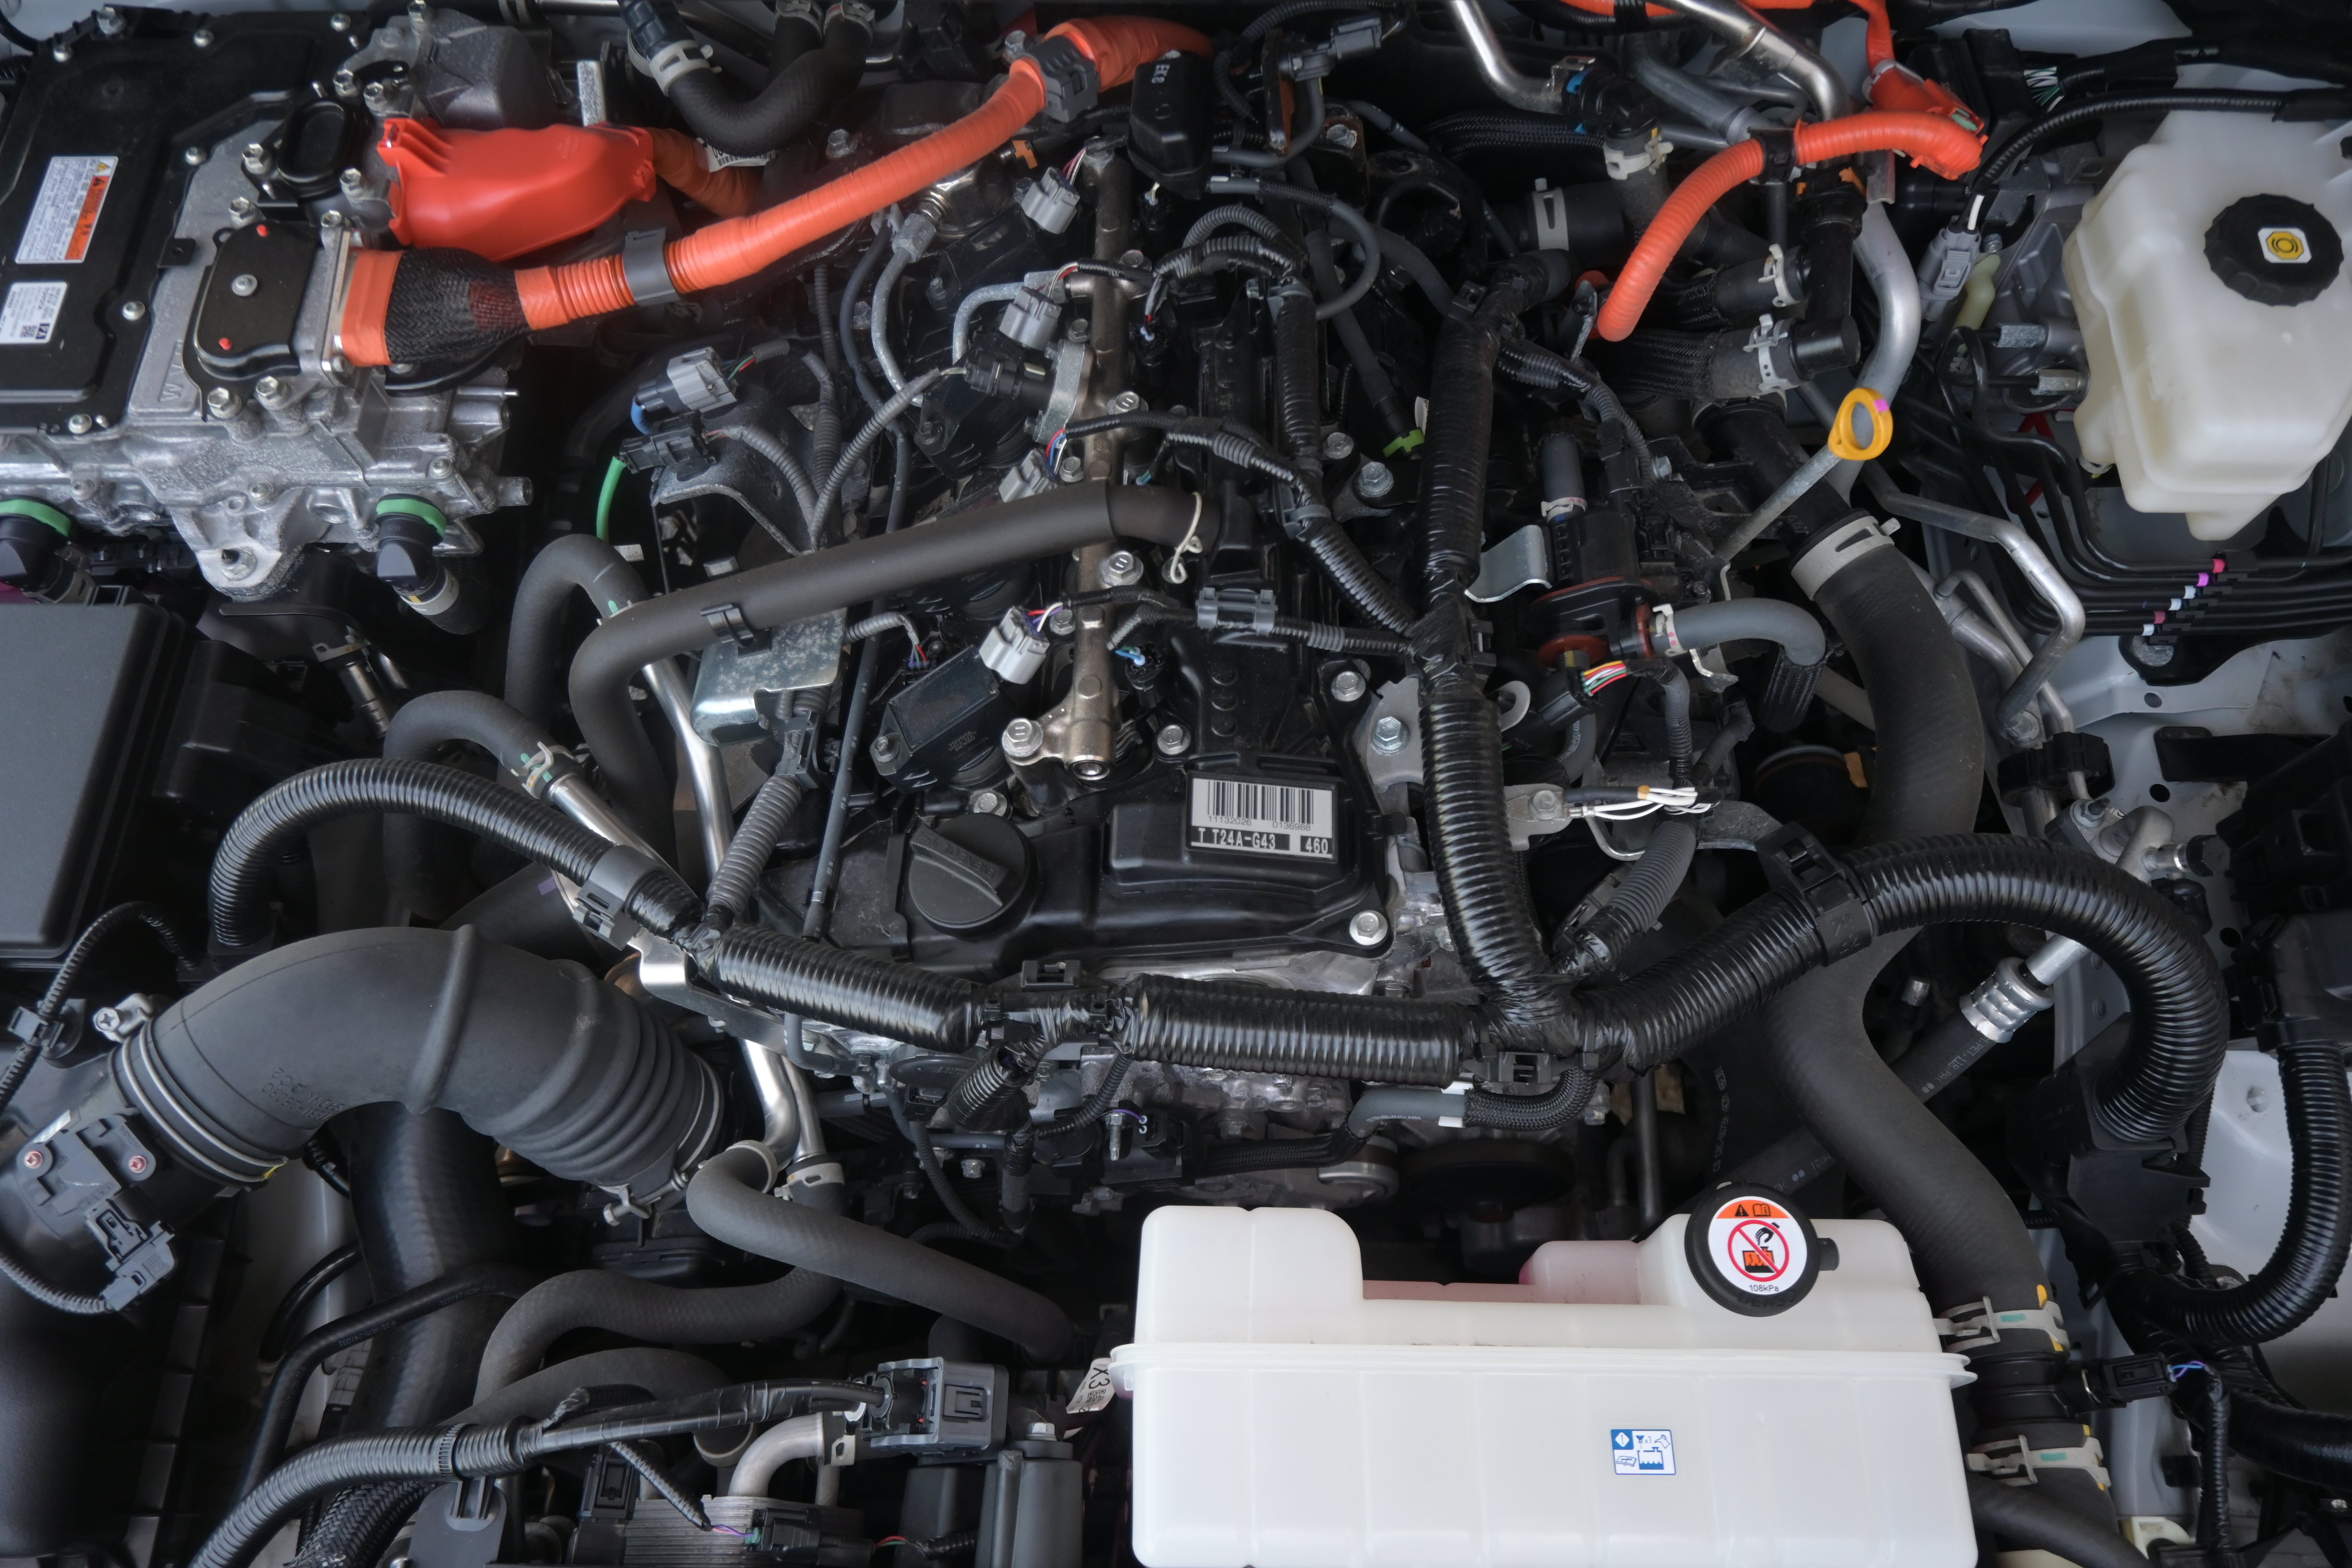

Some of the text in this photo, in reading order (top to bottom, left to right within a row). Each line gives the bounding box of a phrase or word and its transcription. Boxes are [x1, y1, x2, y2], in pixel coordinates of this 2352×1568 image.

[949, 731, 972, 746] TOYOTA
[955, 737, 975, 751] DENSO
[1208, 815, 1312, 831] 11132026 0136988
[1198, 828, 1328, 855] T T24A-G43 460
[944, 843, 997, 880] ENGINE OIL
[1748, 1284, 1779, 1293] 108kPa
[1089, 1367, 1111, 1389] X3
